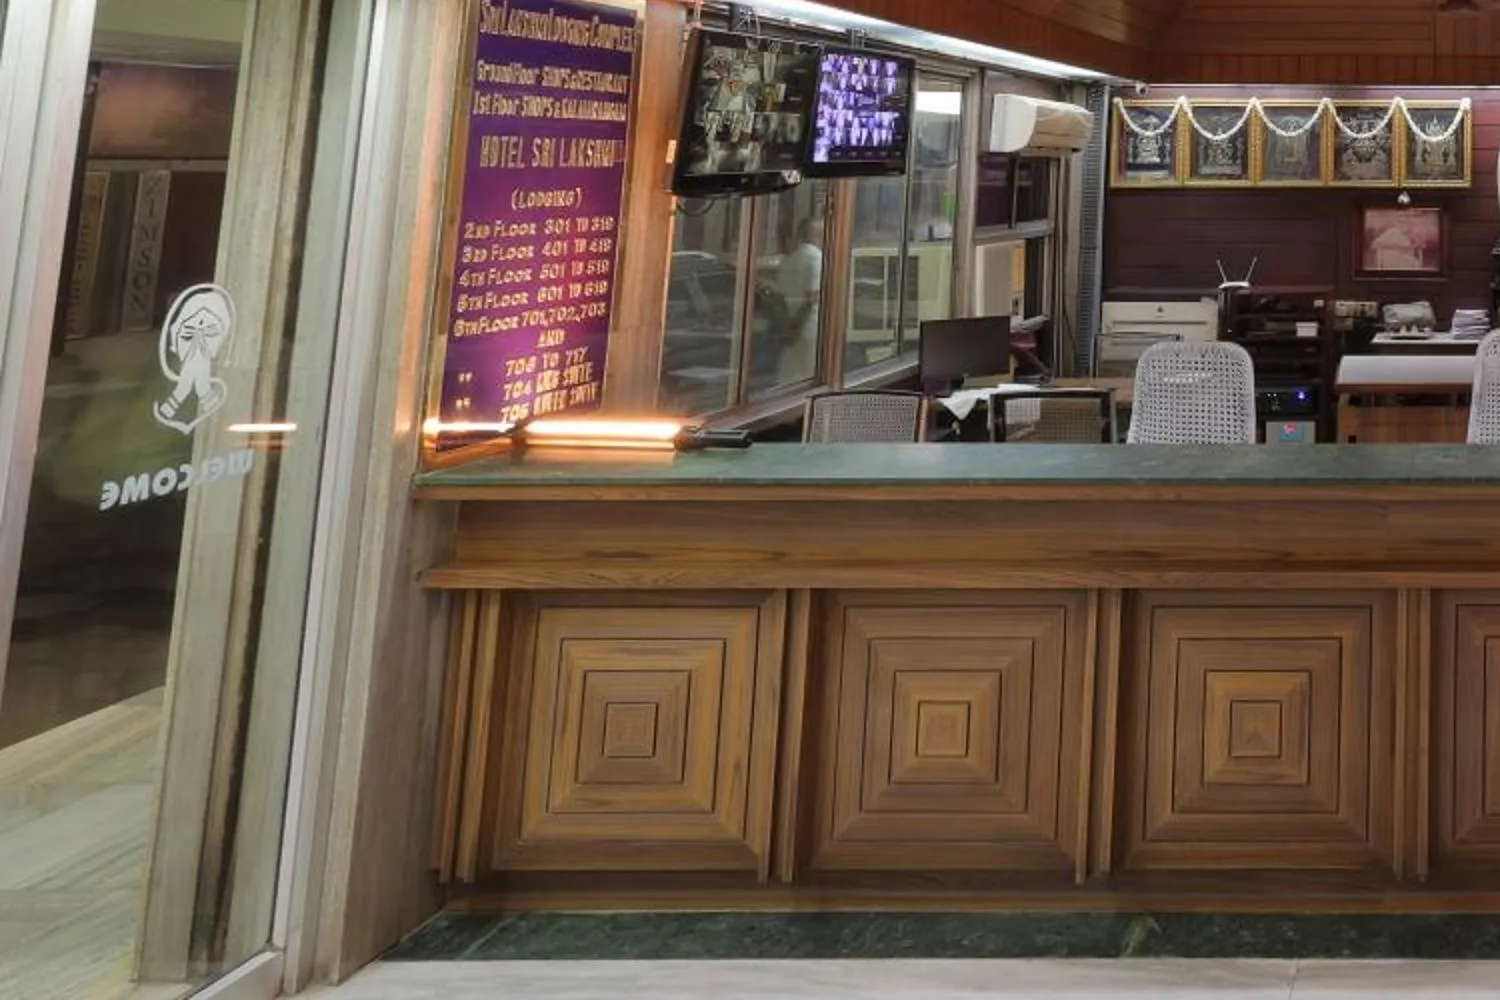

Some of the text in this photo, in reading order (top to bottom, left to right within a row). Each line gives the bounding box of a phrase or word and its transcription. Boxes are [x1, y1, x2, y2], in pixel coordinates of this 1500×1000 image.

[480, 135, 525, 168] HOTEL
[531, 136, 556, 168] SRI
[543, 217, 570, 235] 301
[541, 240, 568, 257] 401
[539, 262, 565, 280] 501
